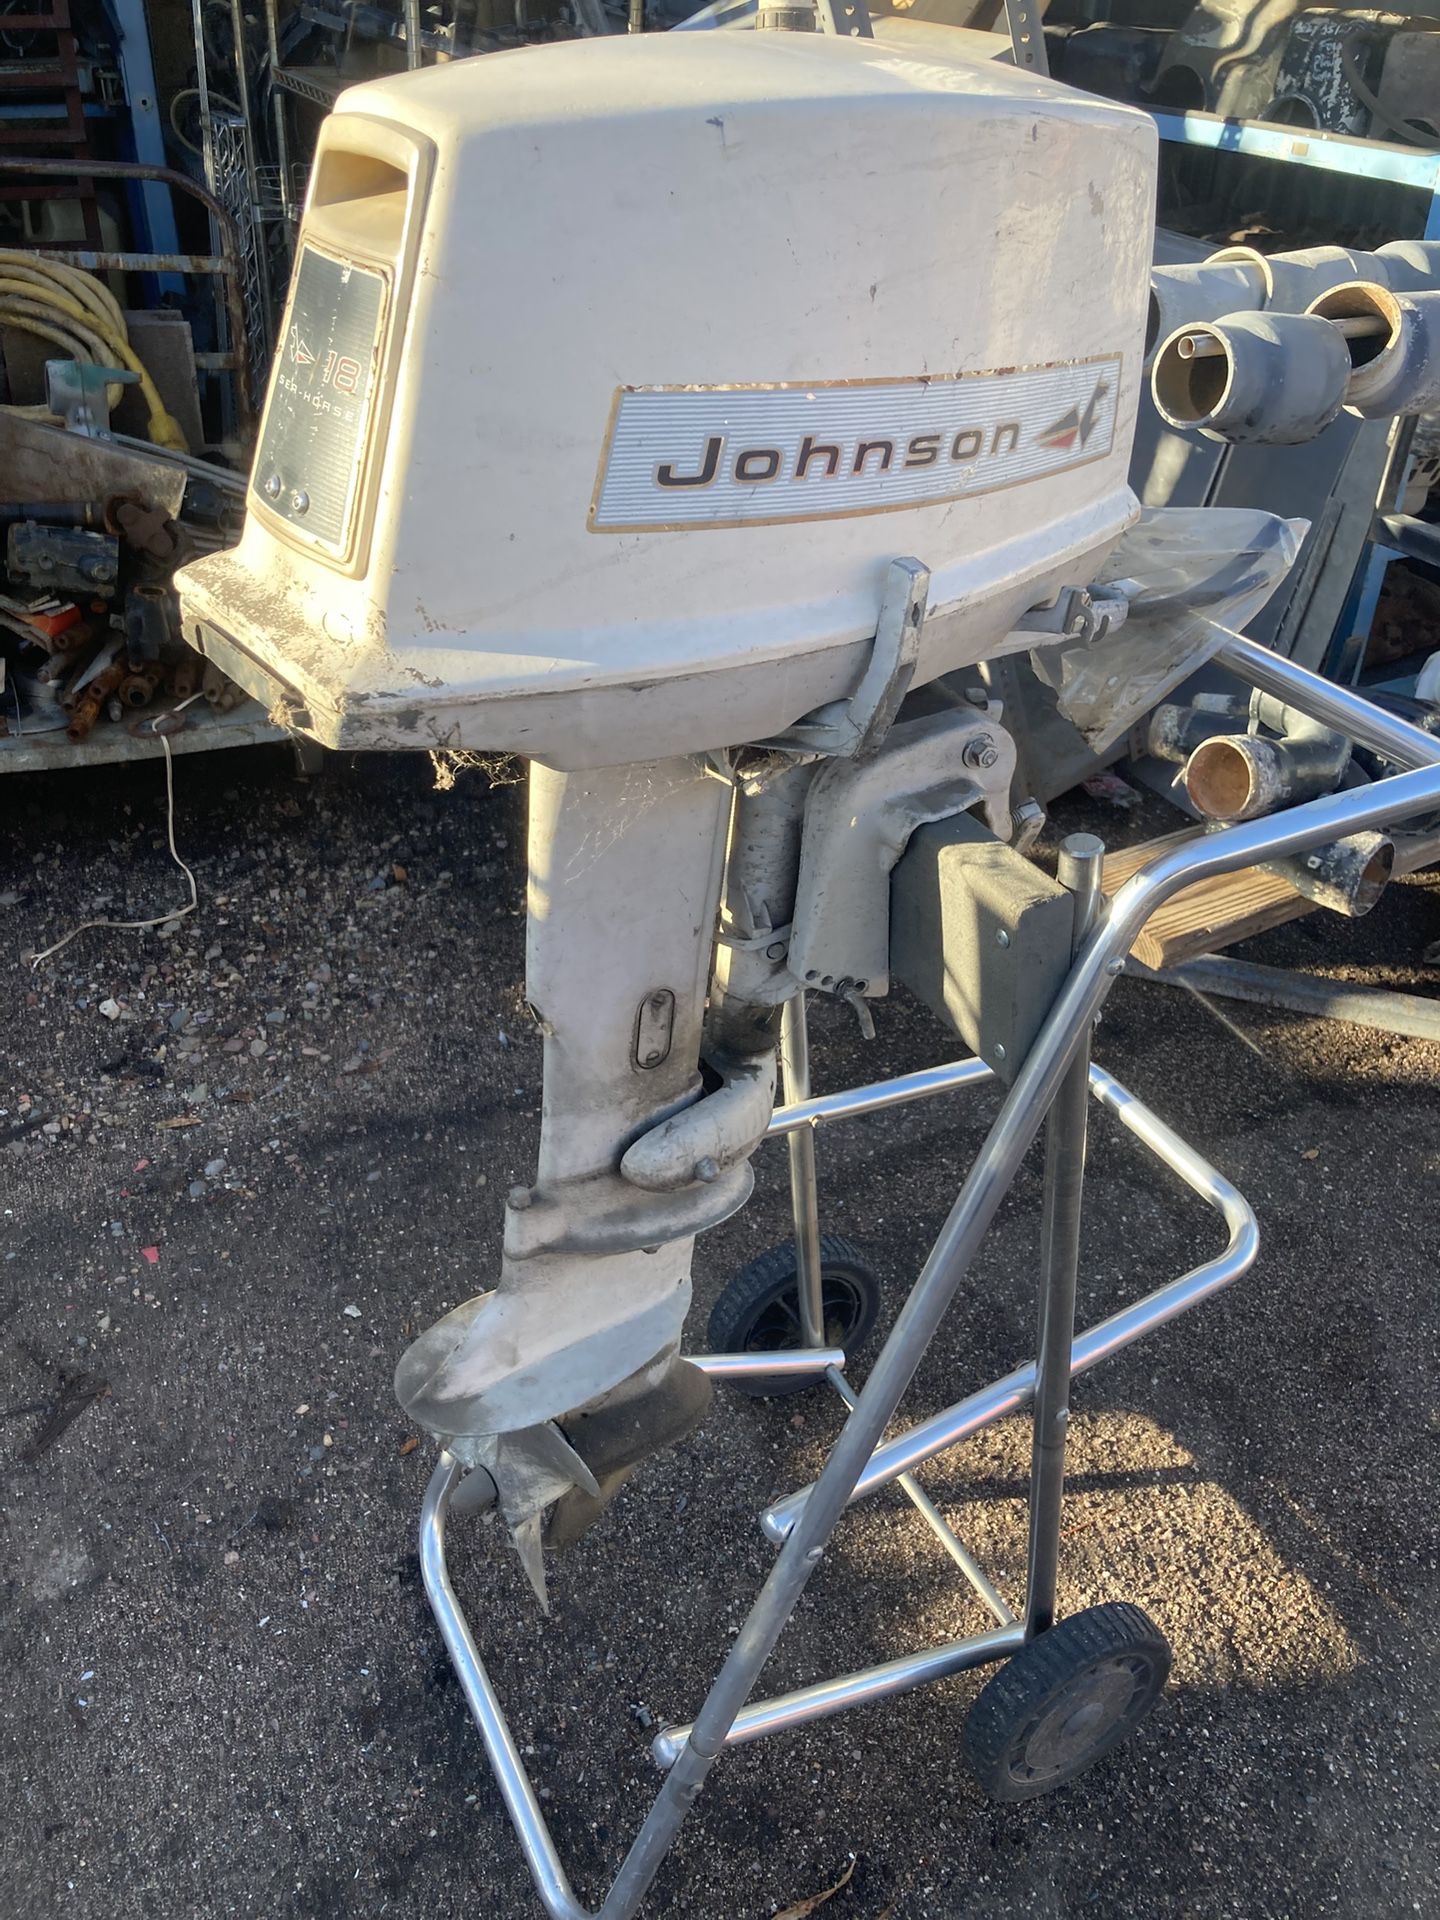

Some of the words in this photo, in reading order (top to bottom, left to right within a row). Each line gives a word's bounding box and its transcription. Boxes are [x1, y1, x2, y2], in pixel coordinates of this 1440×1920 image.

[322, 350, 362, 393] 18
[279, 373, 355, 423] SEA-HORSE
[656, 422, 1021, 489] Johnson
